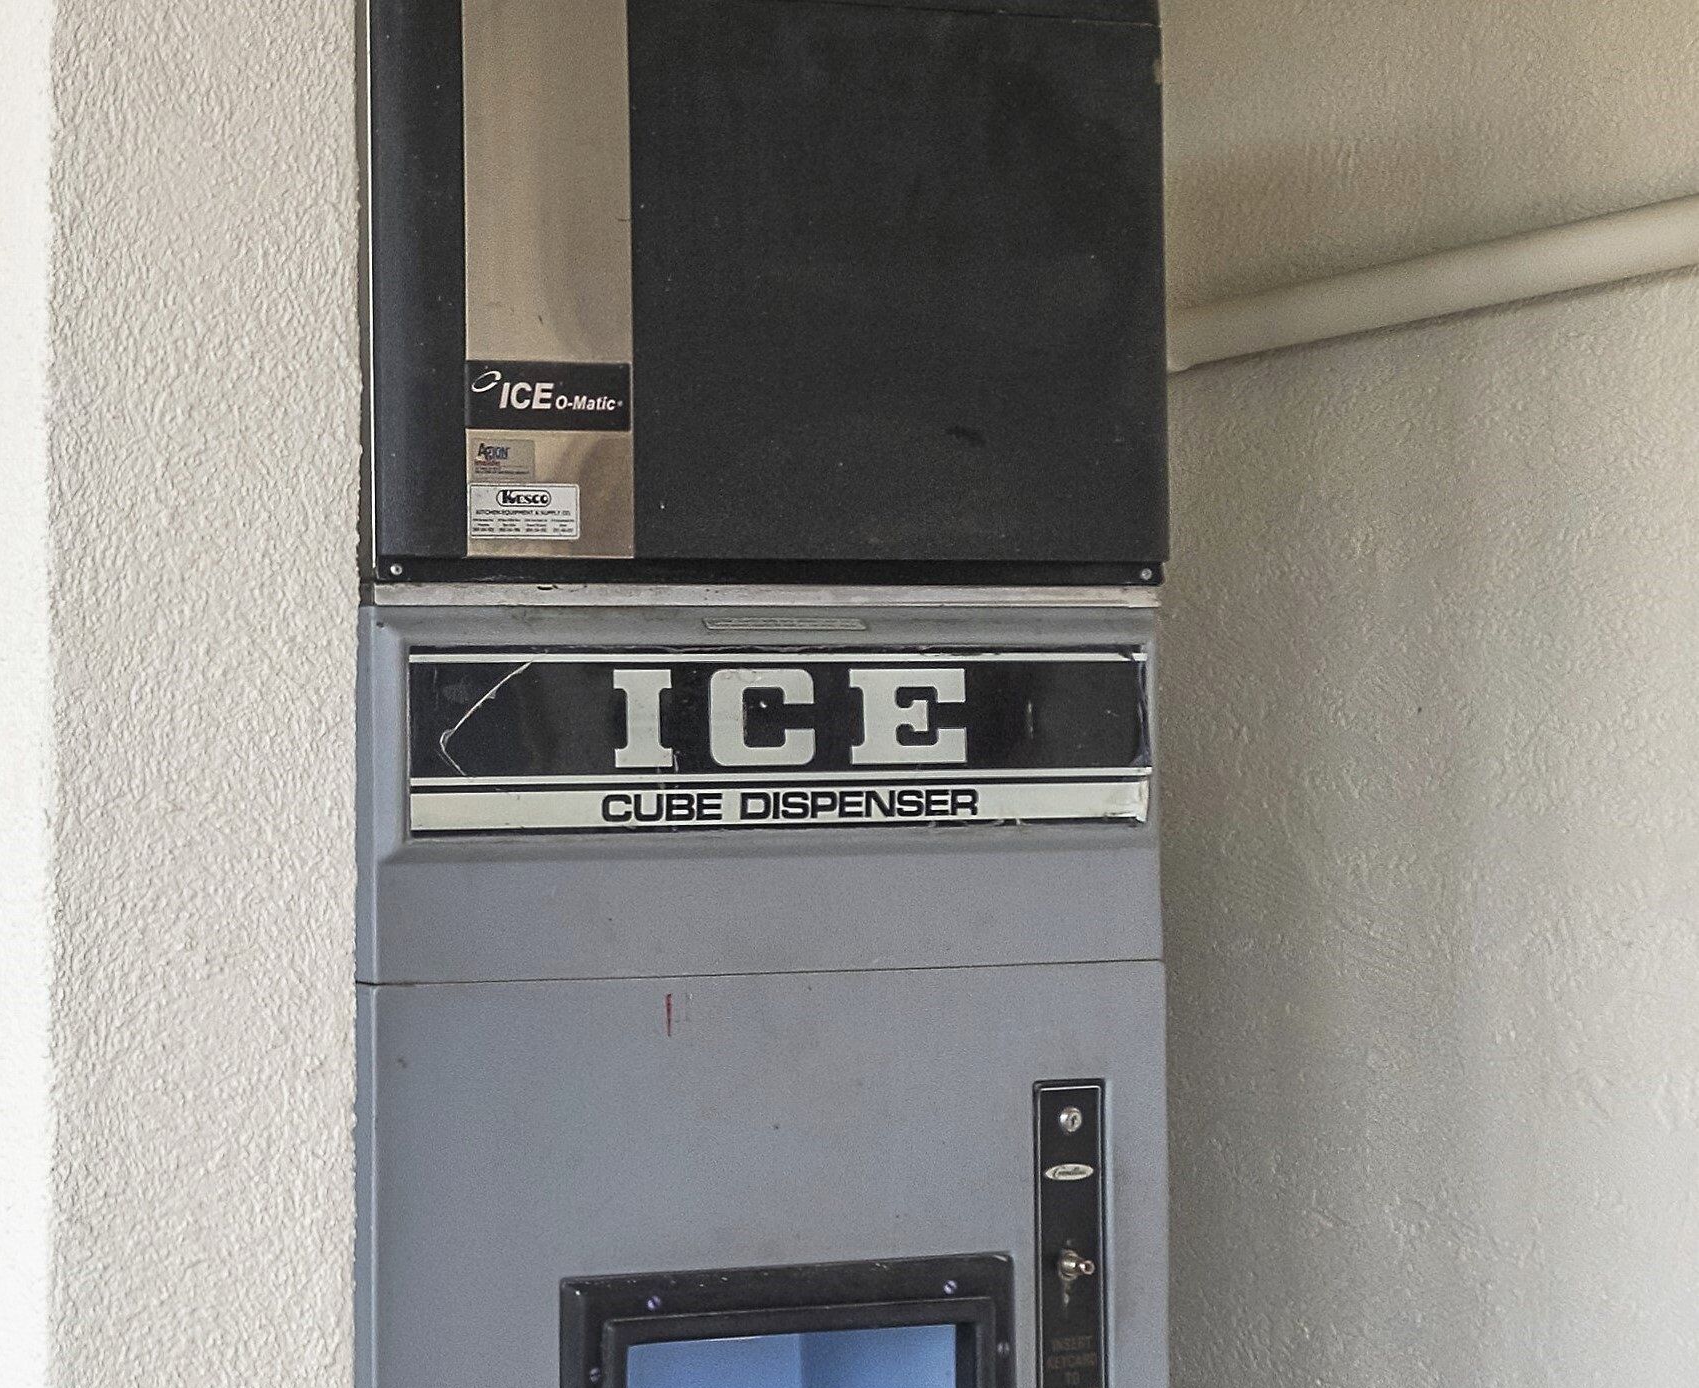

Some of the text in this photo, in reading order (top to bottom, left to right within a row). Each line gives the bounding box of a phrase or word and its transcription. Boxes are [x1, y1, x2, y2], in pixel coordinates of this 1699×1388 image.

[499, 382, 616, 410] ICE O-Matic
[613, 668, 966, 767] ICE
[602, 788, 979, 822] CUBE DISPENSER
[1052, 1336, 1092, 1352] INSERT
[1064, 1371, 1080, 1385] TO
